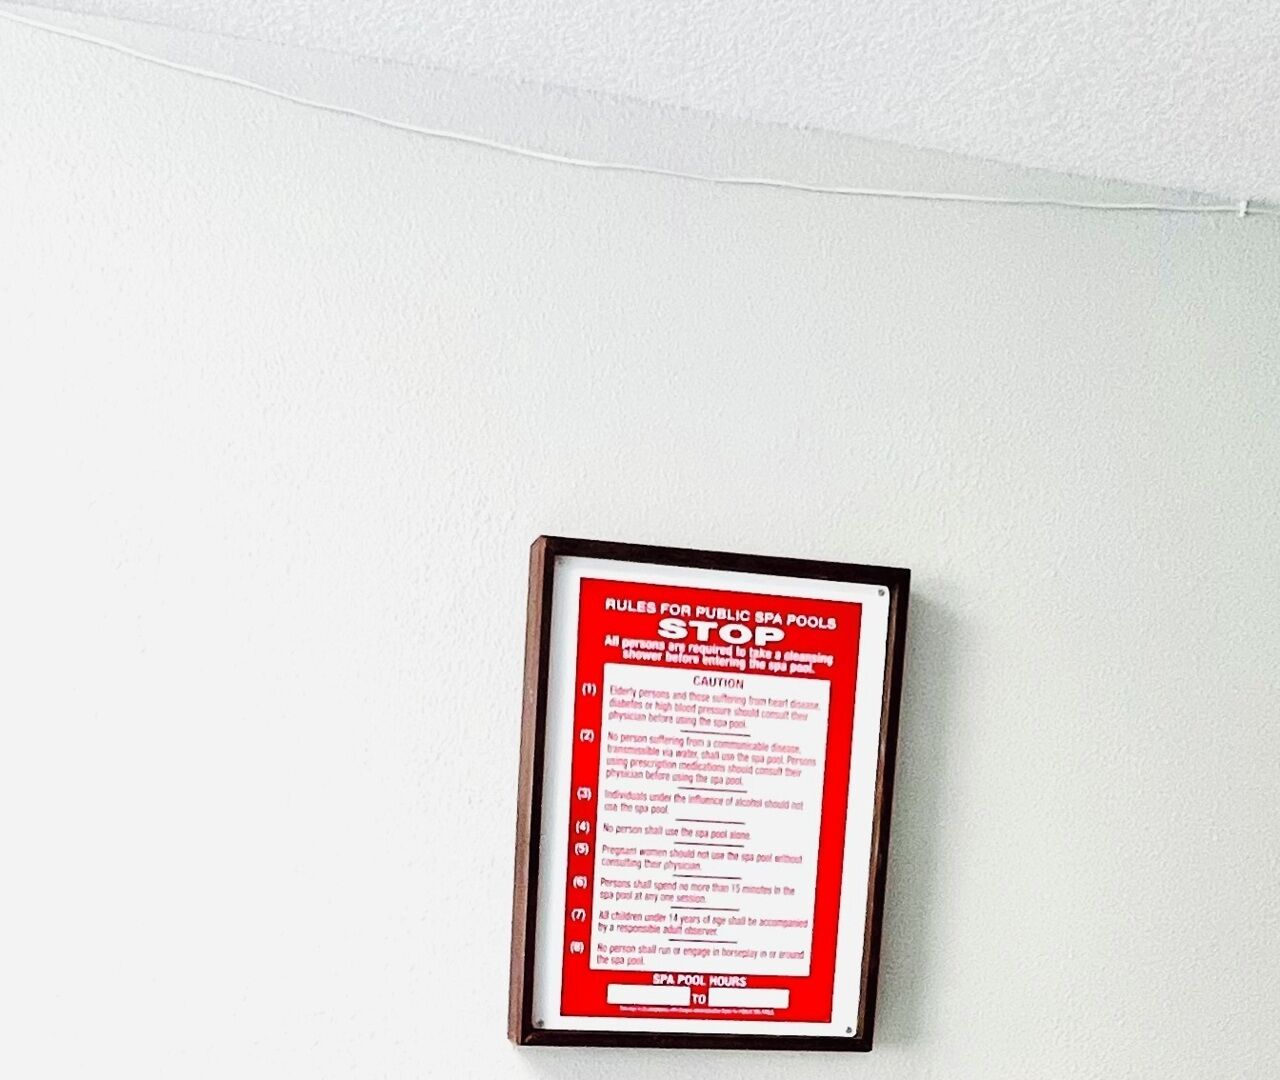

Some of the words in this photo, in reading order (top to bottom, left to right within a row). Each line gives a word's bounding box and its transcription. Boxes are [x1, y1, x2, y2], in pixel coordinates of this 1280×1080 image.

[605, 597, 655, 614] RULES
[660, 602, 690, 617] FOR
[695, 605, 749, 622] PUBLIC
[755, 610, 781, 625] SPA
[787, 613, 836, 630] POOLS
[658, 616, 784, 648] STOP
[604, 634, 619, 646] All
[622, 636, 664, 651] persons
[668, 640, 685, 651] are
[688, 641, 732, 657] required
[735, 645, 745, 656] to
[749, 646, 771, 658] take
[775, 648, 781, 659] a
[784, 649, 833, 665] cleansing
[622, 648, 661, 661] shower
[665, 651, 699, 664] before
[702, 654, 745, 669] entering
[749, 658, 765, 669] the
[768, 659, 787, 673] spa
[789, 661, 815, 675] pool.
[692, 675, 744, 689] CAUTION
[652, 973, 674, 984] SPA
[677, 974, 705, 985] POOL
[709, 975, 746, 987] HOURS
[692, 994, 706, 1004] TO
